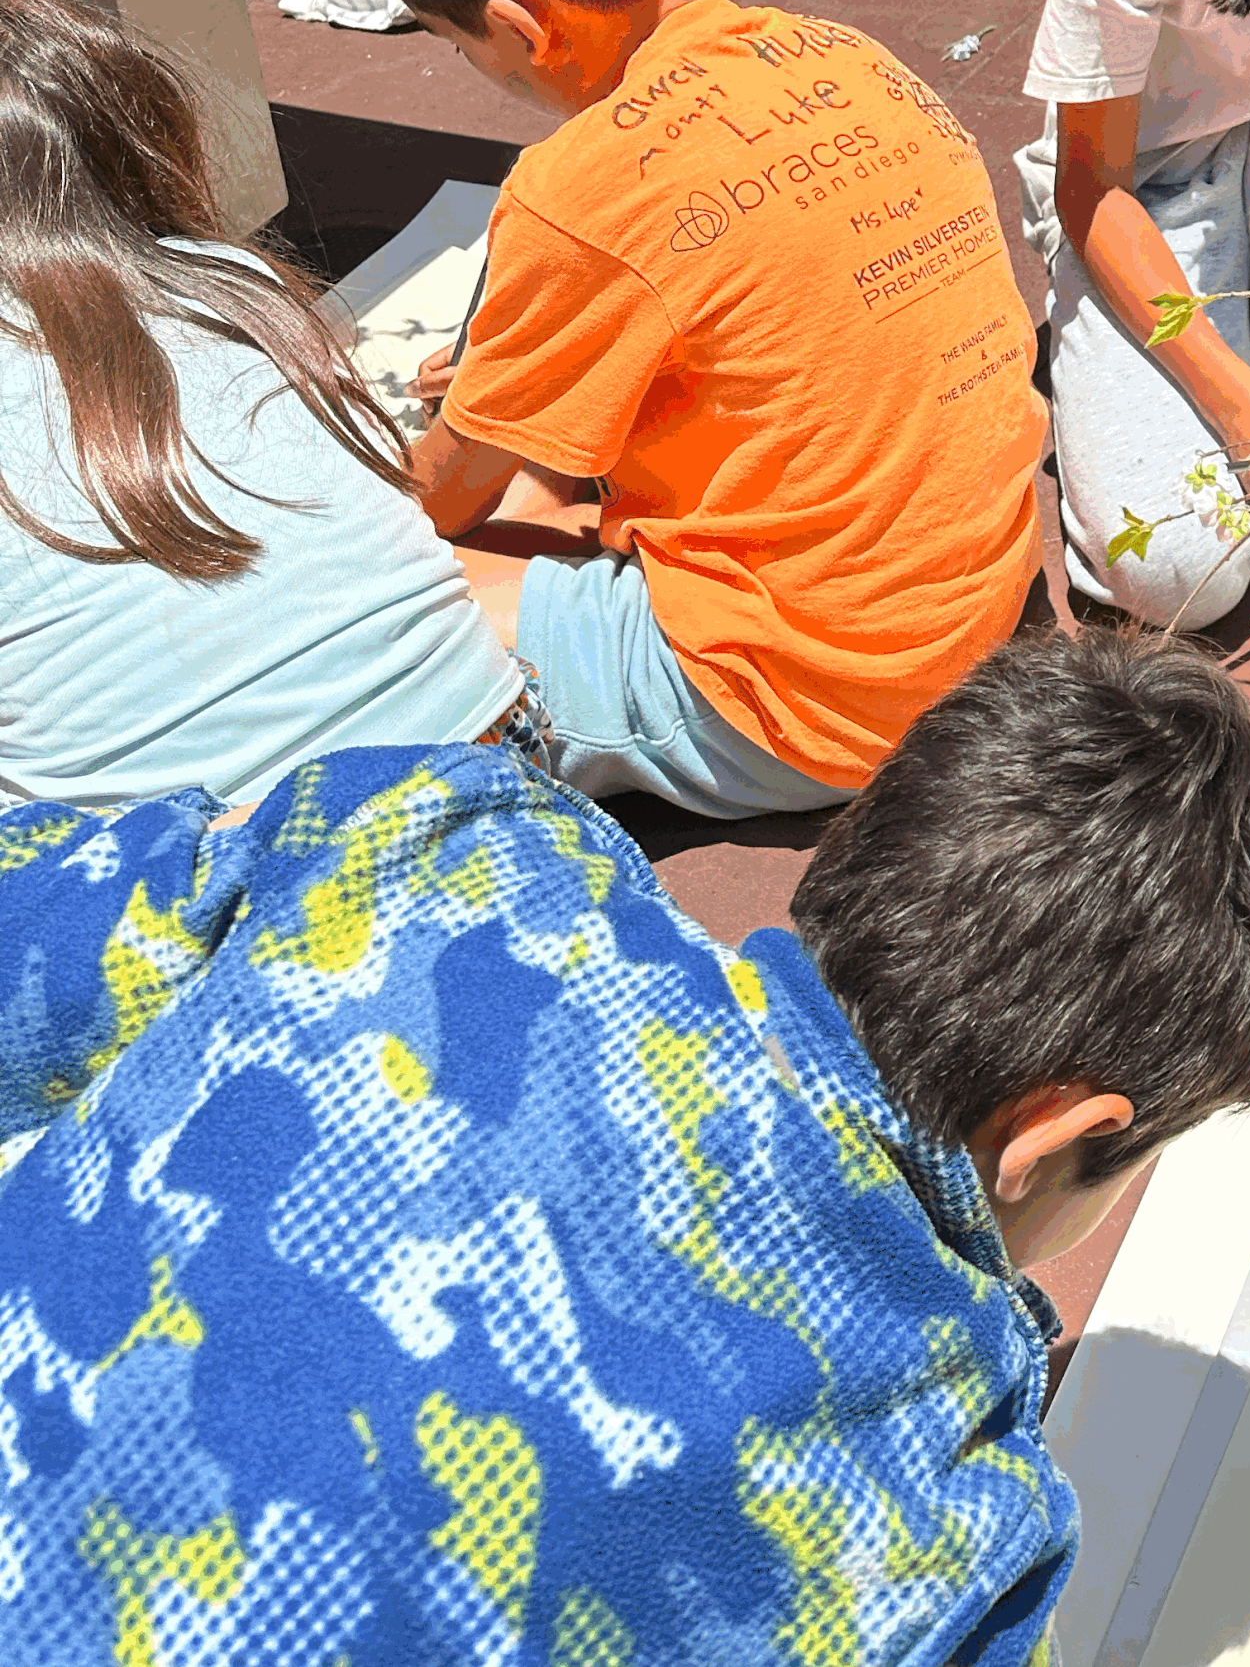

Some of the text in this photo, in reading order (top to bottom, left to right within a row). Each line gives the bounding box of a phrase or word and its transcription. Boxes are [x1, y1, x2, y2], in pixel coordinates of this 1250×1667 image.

[717, 80, 852, 145] Luke
[721, 124, 878, 214] braces
[795, 140, 920, 210] san diego
[853, 204, 990, 288] KEVIN SILVERSTEIN
[863, 225, 997, 310] PREMIER HOMES
[939, 268, 966, 289] TEAM
[941, 314, 1008, 364] THE WANG FAMILY
[981, 350, 988, 360] &
[938, 388, 960, 406] THE
